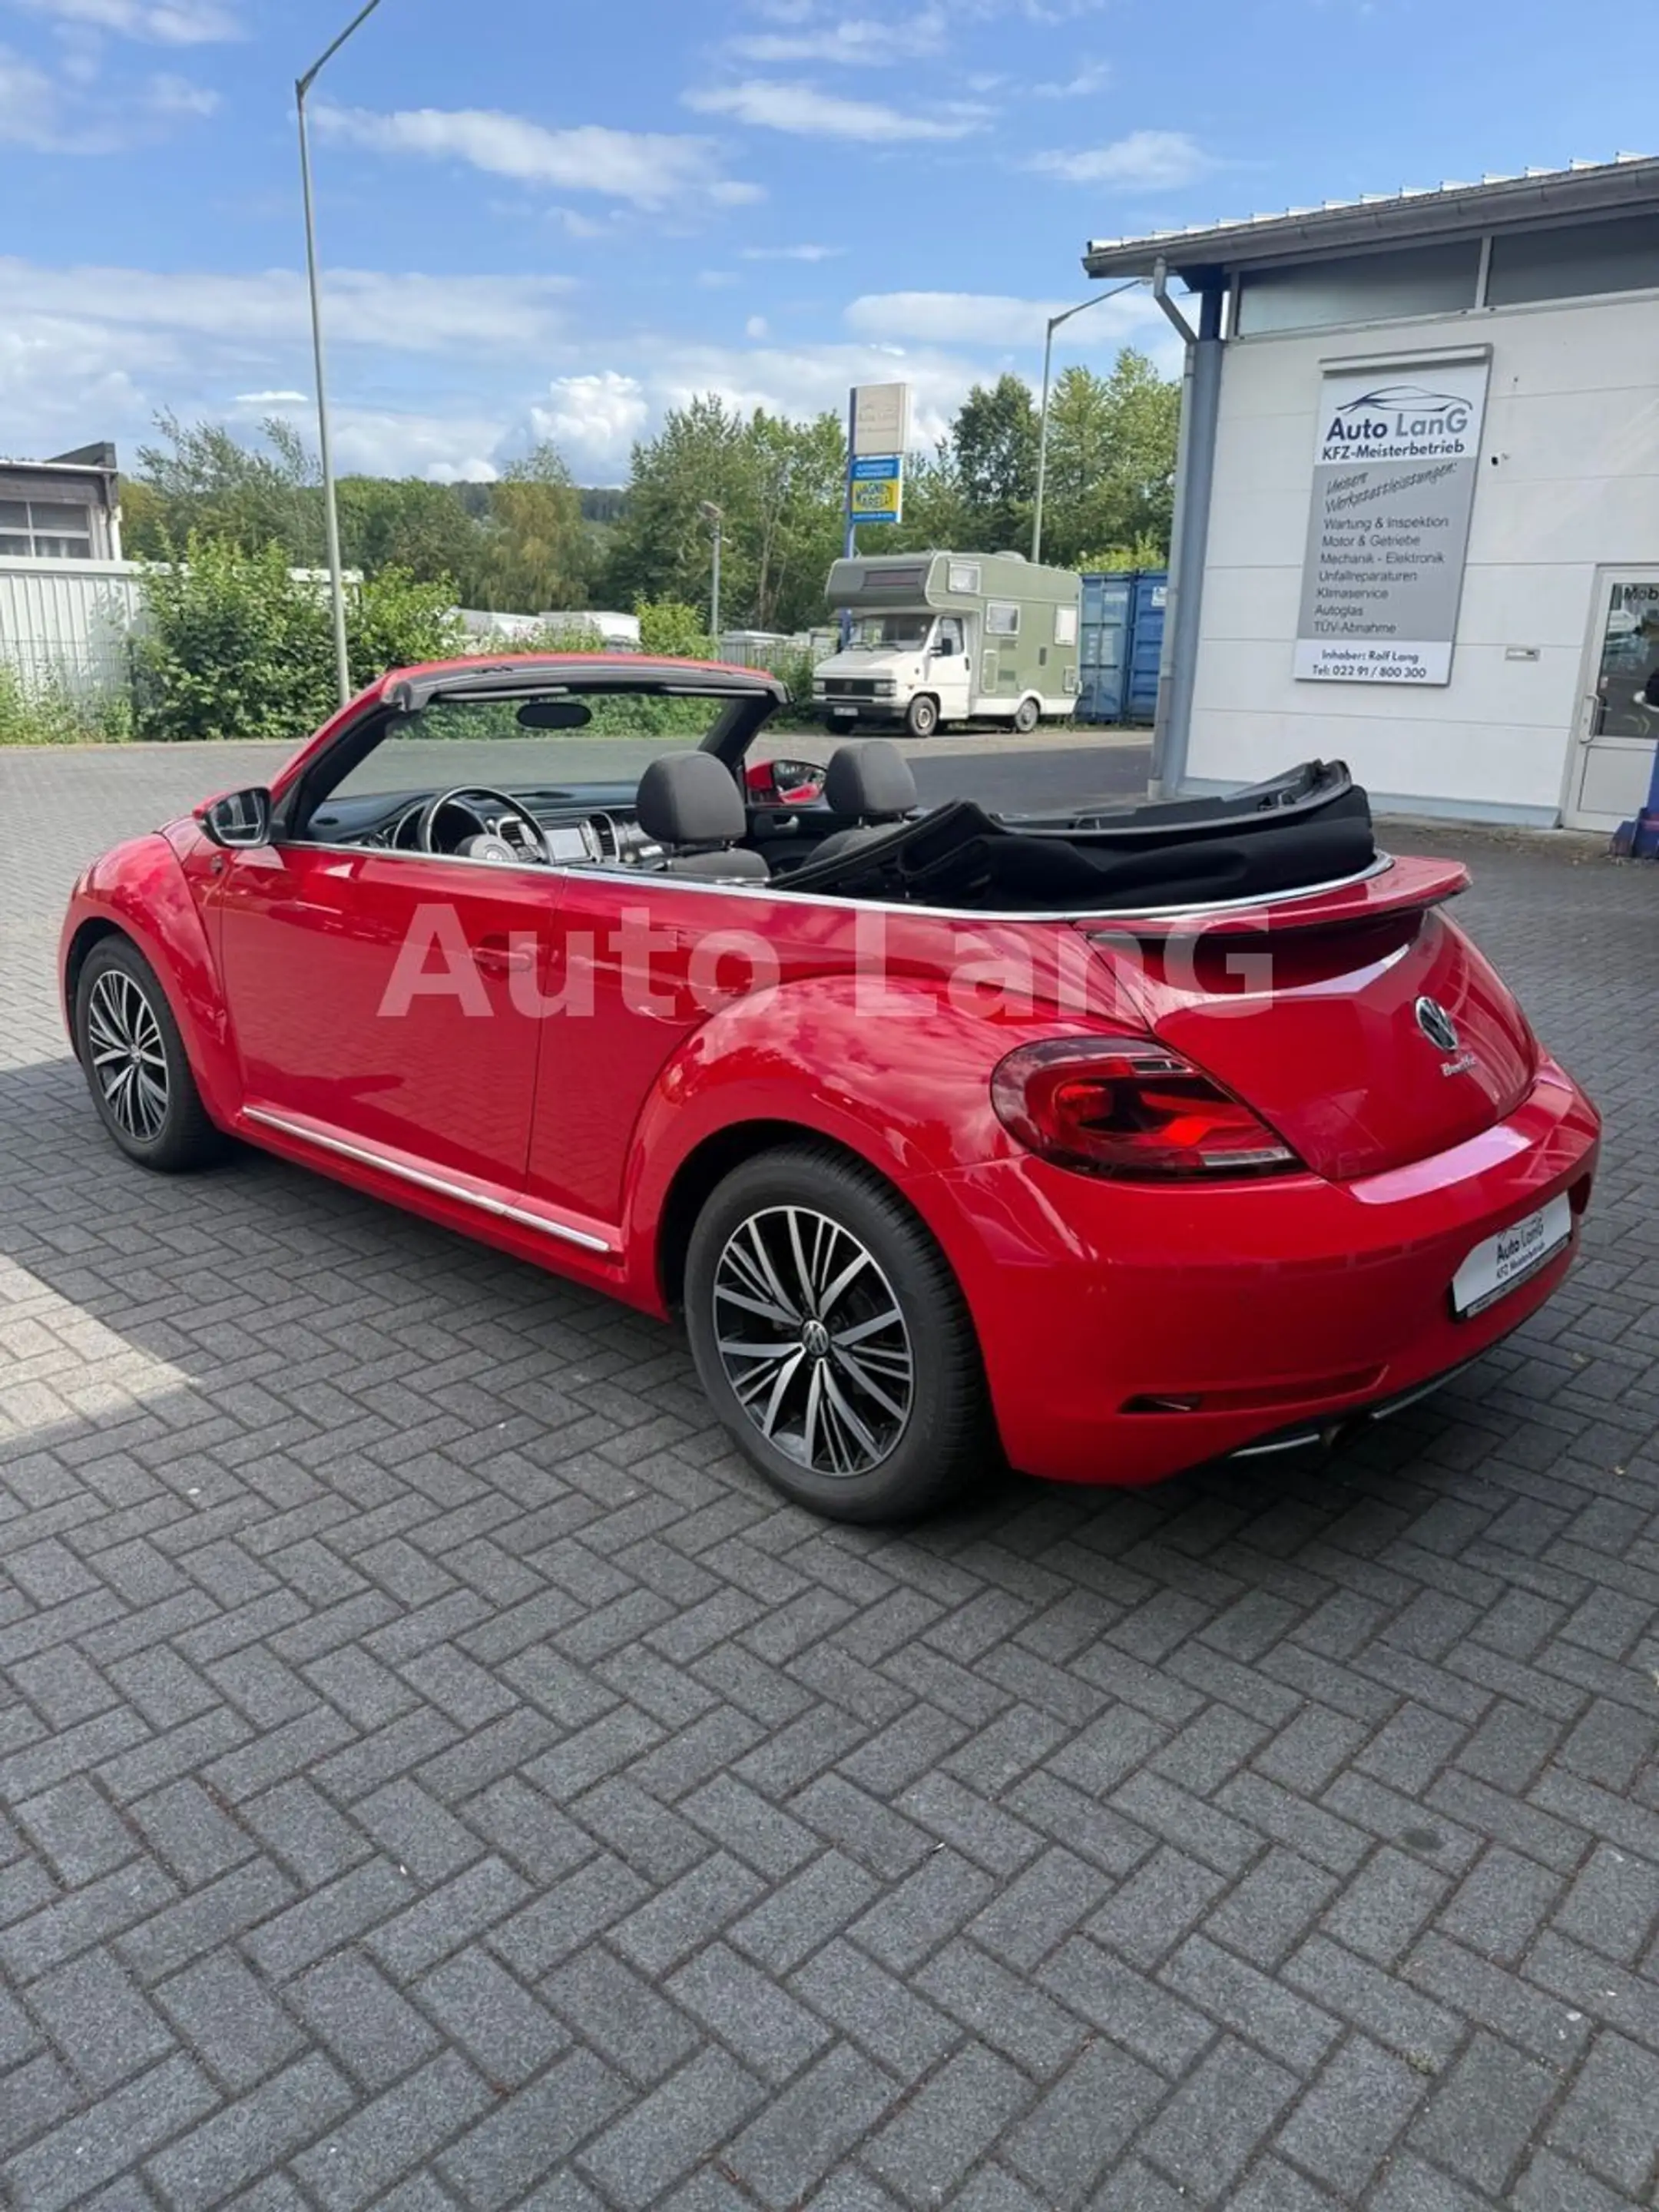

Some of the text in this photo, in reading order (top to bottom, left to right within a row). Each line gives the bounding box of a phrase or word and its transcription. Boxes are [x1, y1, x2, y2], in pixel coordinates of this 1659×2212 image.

[1326, 408, 1468, 442] Auto LanG
[1322, 439, 1465, 460] KFZ-Meisterbetrieb
[1323, 516, 1449, 532] Wartung & Inspektion
[1322, 535, 1421, 547] Motor & Getriebe
[1320, 552, 1374, 565] Mechanik
[1386, 551, 1445, 565] Elektronik
[1318, 570, 1417, 584] Unfallreparaturen
[1316, 588, 1389, 599] Klimaservice
[1314, 604, 1363, 618] Autoglas
[1392, 651, 1419, 664] Lang
[1333, 665, 1354, 676] 022
[1404, 667, 1427, 678] 300
[1496, 1238, 1519, 1264] Auto
